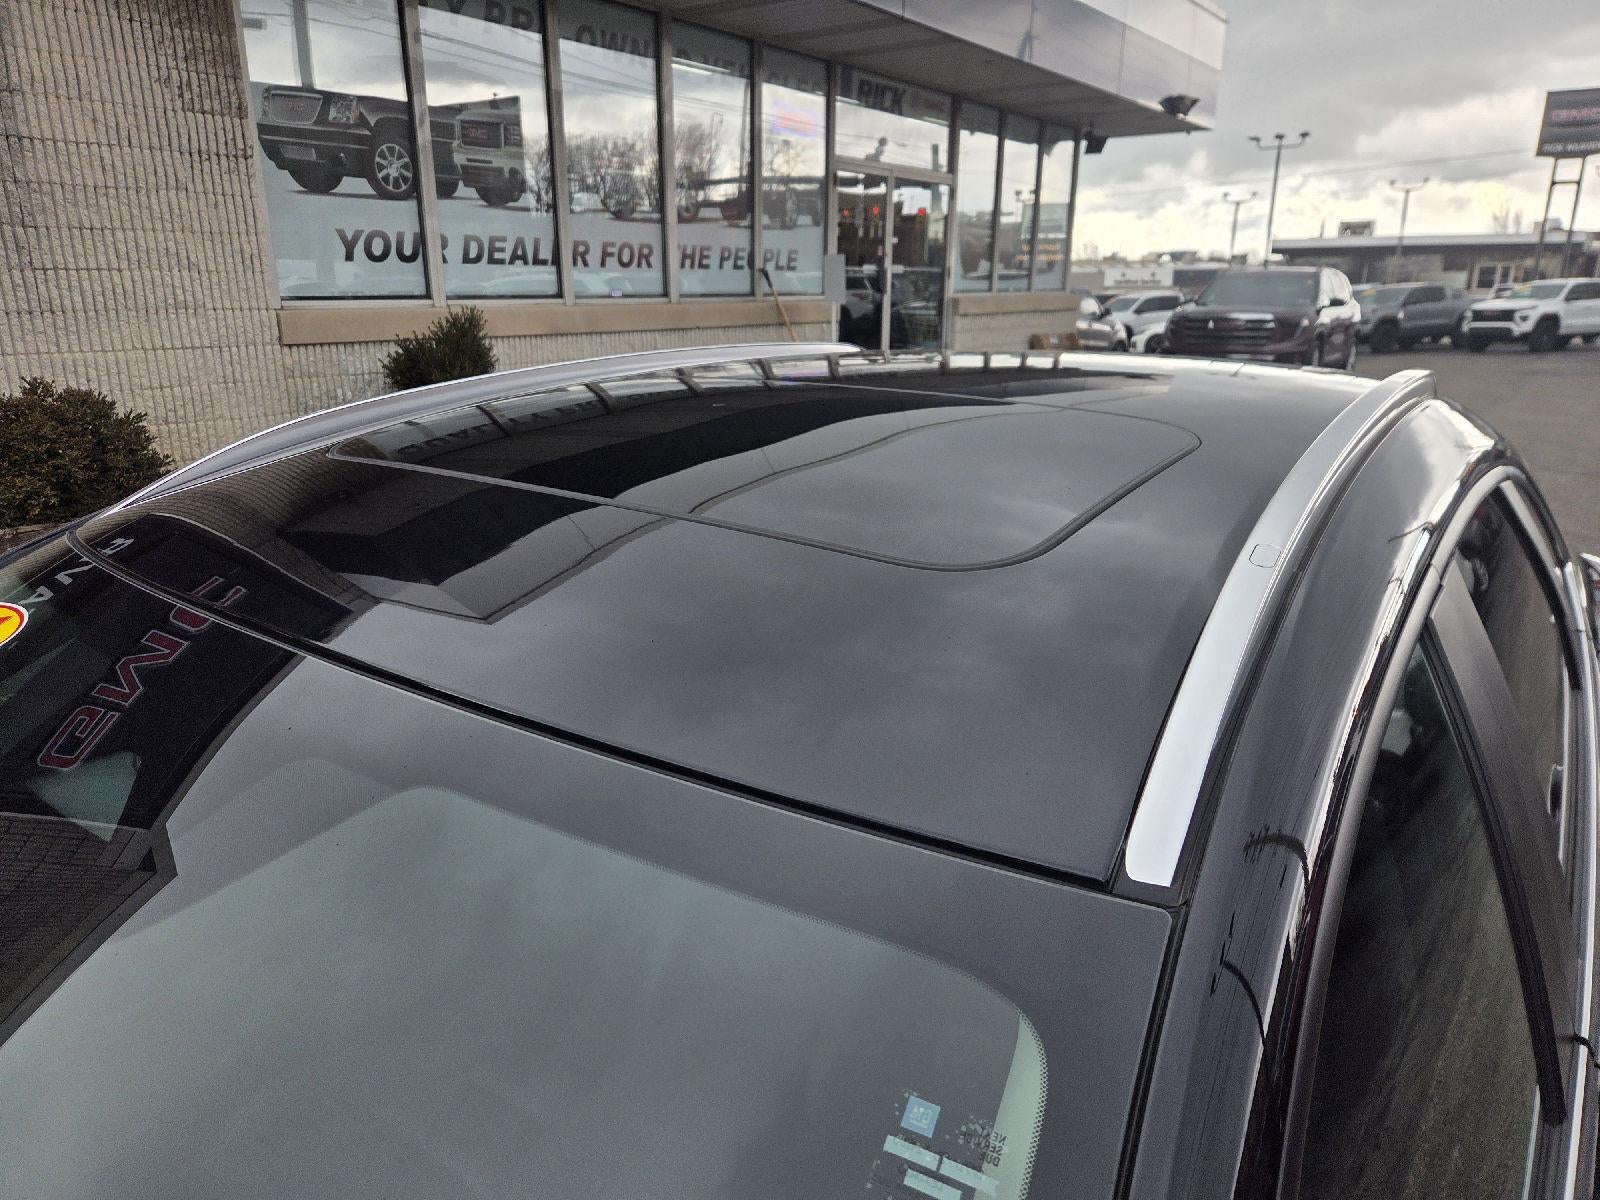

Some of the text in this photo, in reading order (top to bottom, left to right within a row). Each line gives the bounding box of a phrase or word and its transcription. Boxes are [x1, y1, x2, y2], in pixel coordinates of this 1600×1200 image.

[462, 233, 590, 270] DEALR
[600, 241, 654, 270] FOR
[678, 243, 712, 270] HE
[719, 246, 798, 272] PEPLE
